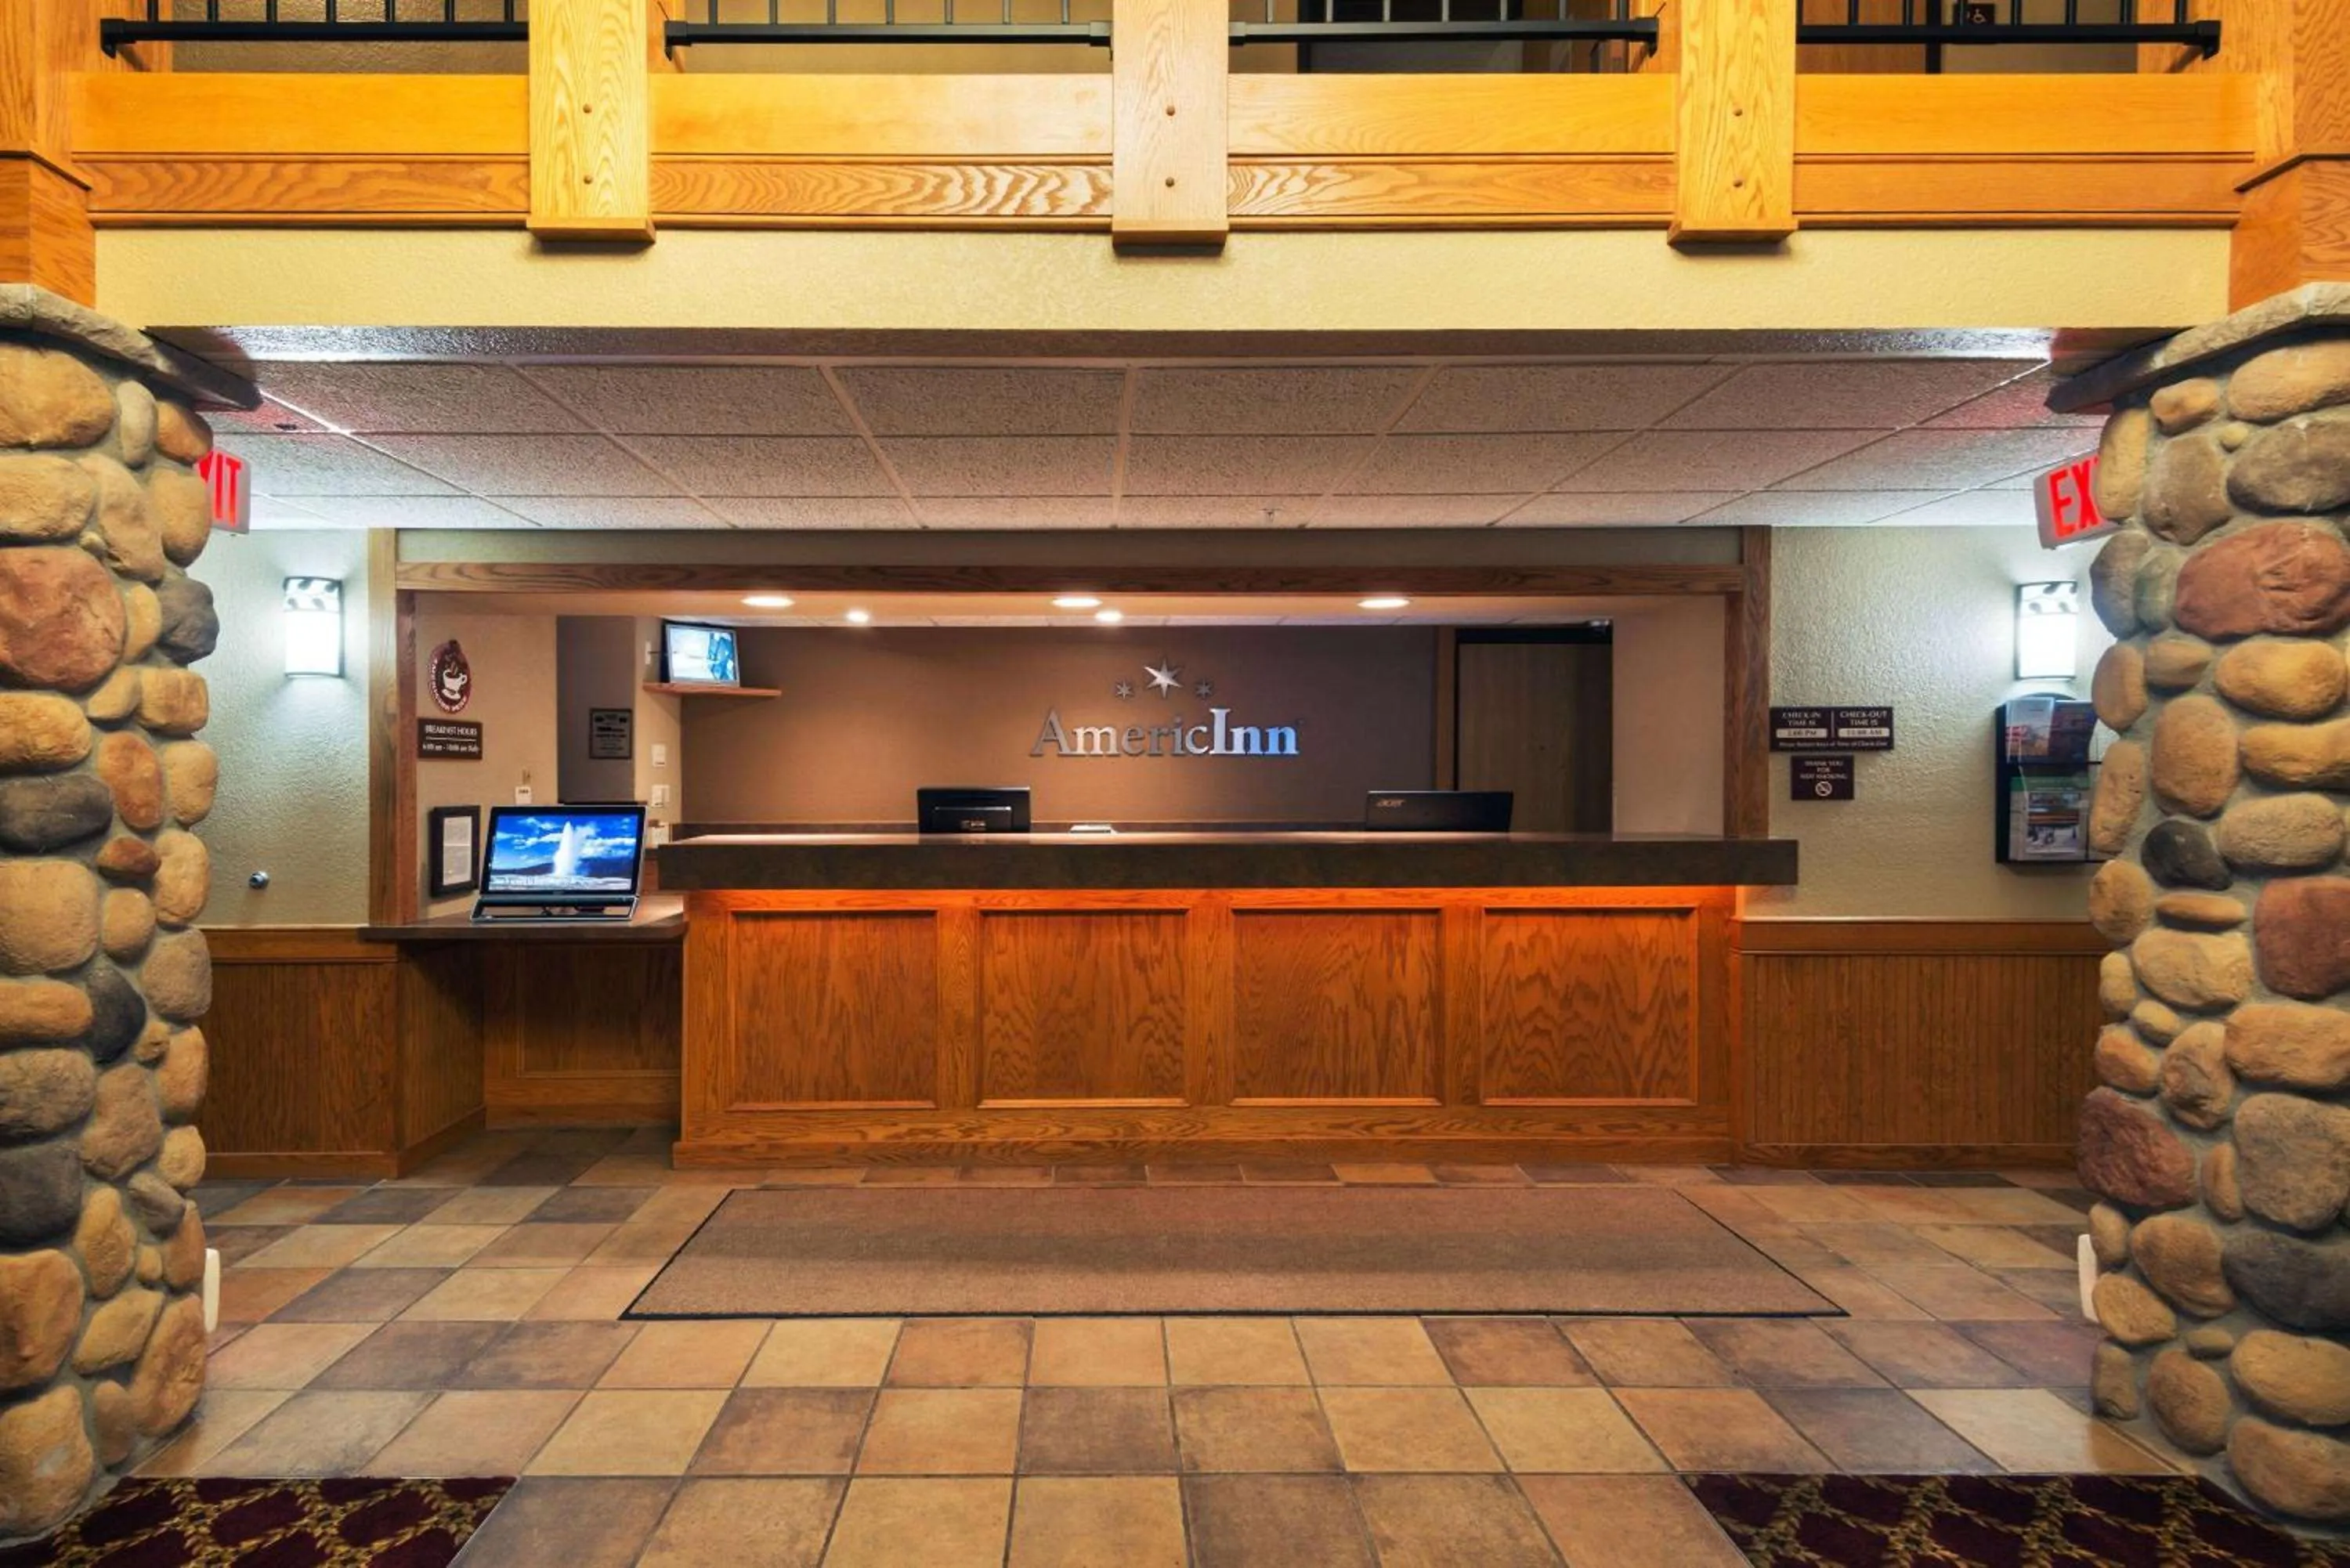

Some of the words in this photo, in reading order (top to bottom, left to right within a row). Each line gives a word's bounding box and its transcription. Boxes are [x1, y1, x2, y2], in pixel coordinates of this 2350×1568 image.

[2048, 454, 2102, 538] EX
[1029, 706, 1300, 758] AmericInn
[1839, 710, 1889, 719] CHECK-OUT
